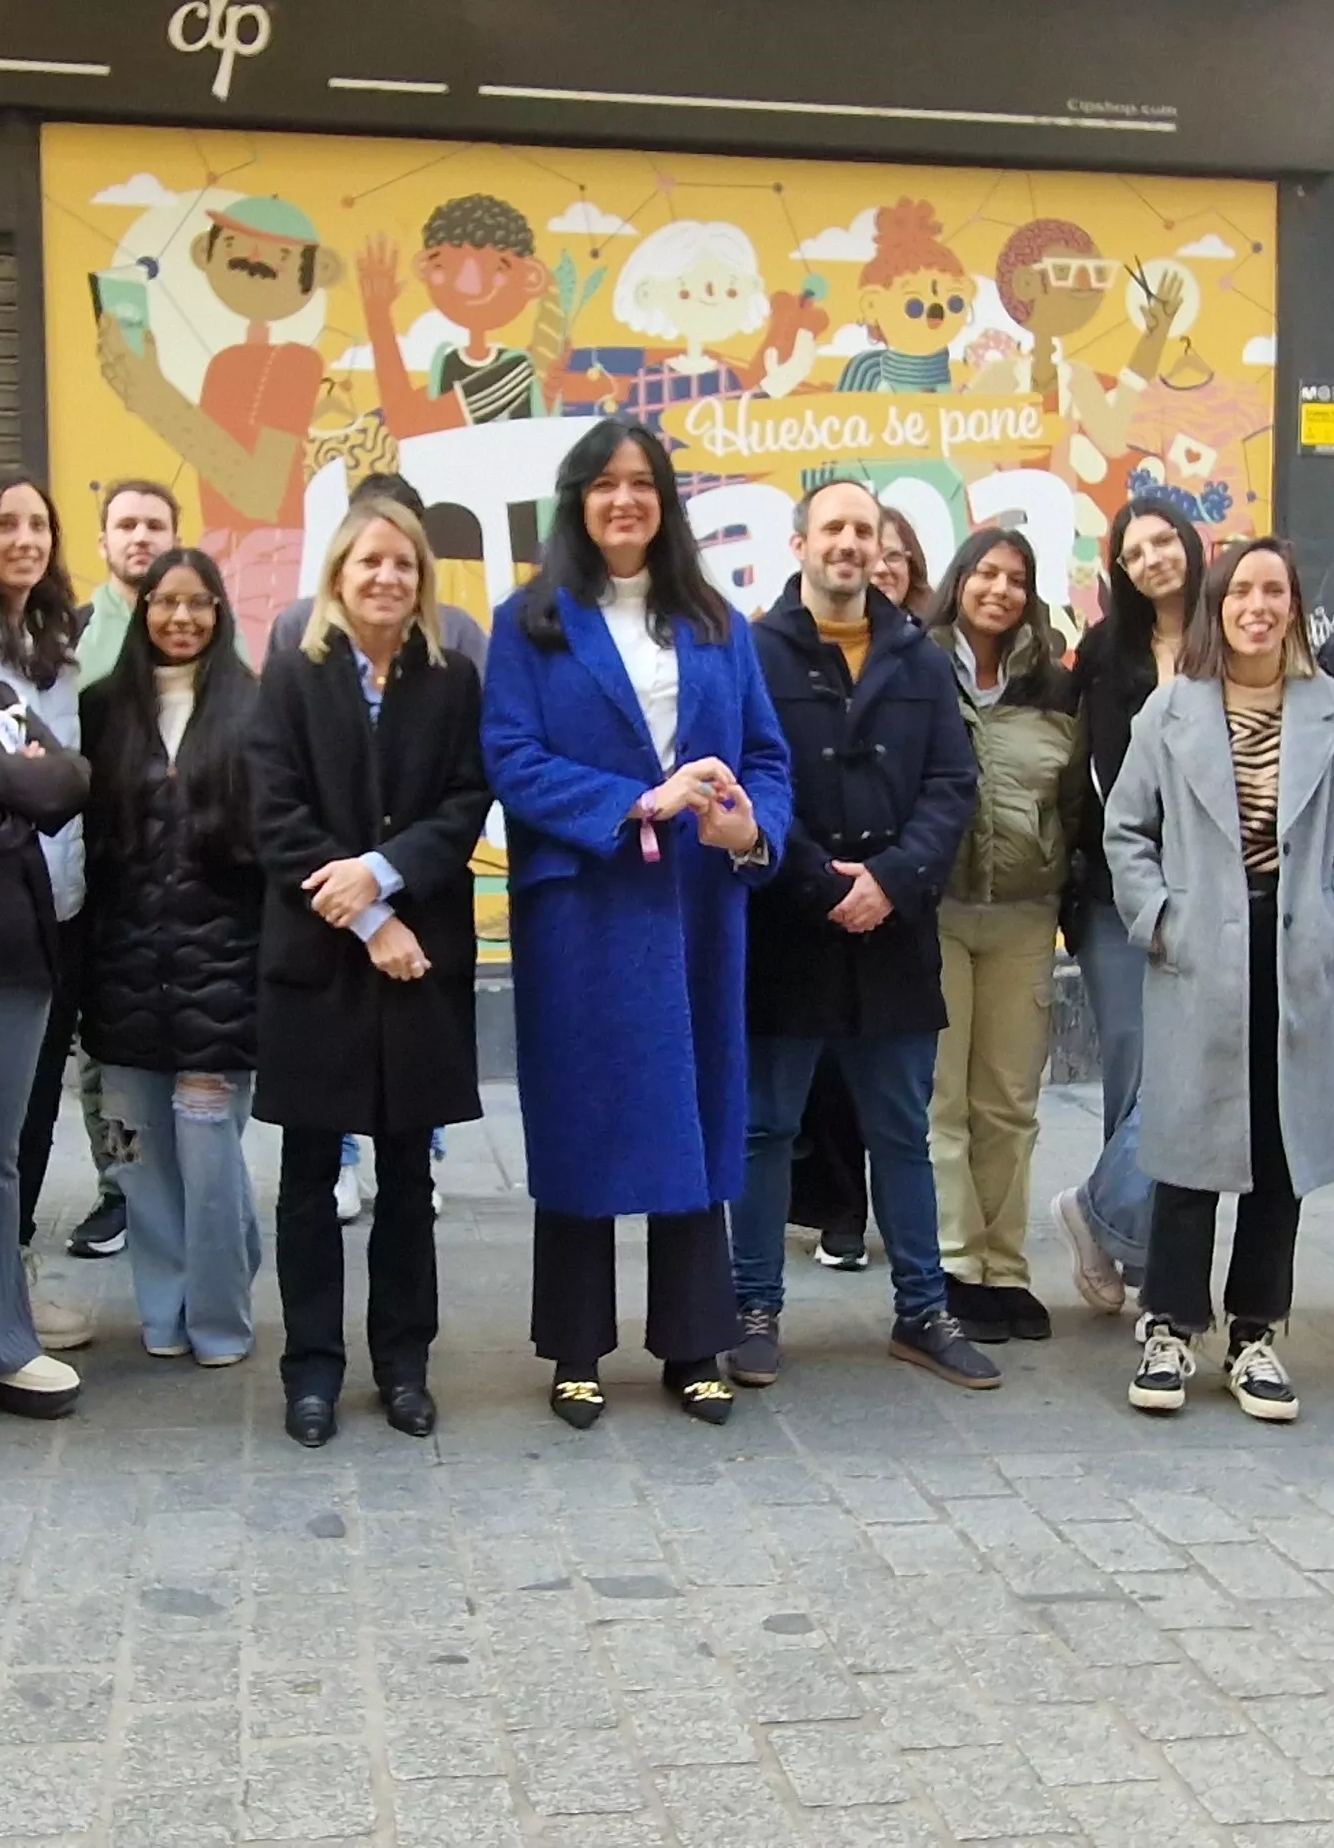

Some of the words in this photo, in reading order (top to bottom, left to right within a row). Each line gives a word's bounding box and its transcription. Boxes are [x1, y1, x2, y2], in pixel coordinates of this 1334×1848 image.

[684, 396, 871, 457] Huesca
[882, 405, 929, 446] se
[940, 402, 1044, 458] pone
